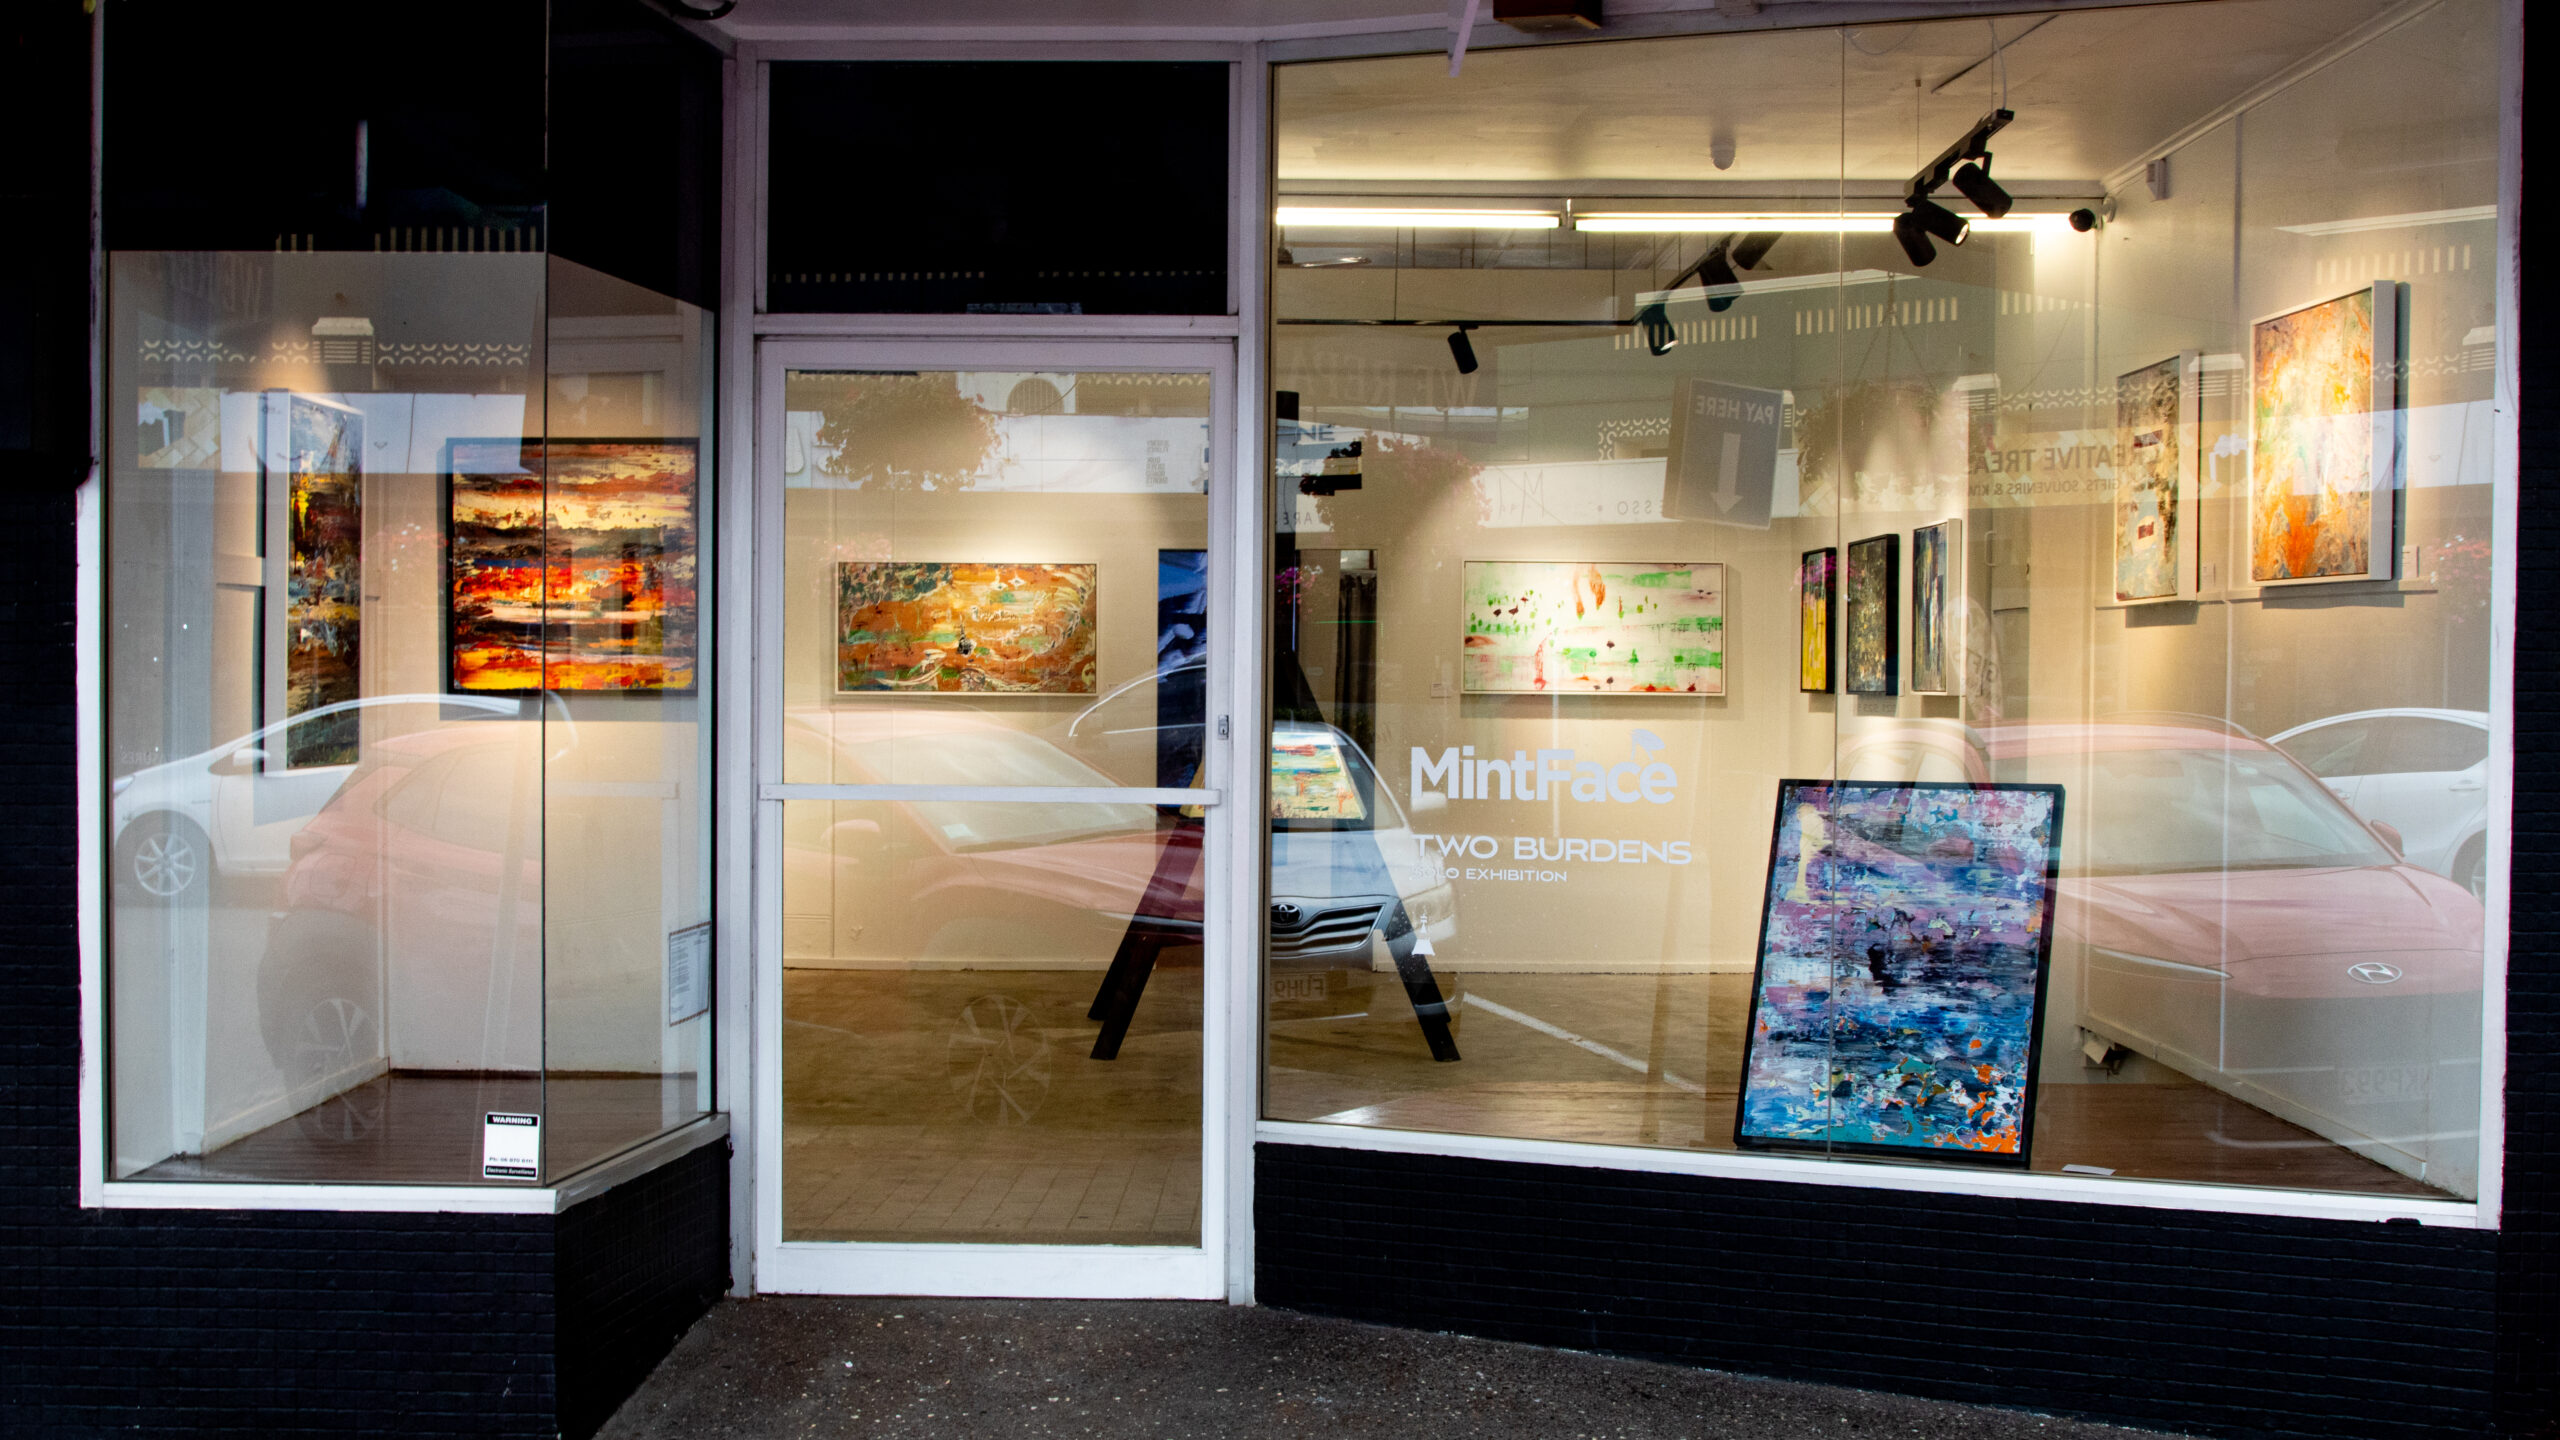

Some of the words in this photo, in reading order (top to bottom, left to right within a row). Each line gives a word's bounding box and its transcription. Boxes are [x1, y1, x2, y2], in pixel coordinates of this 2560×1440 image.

[1410, 745, 1678, 804] MintFace
[1411, 834, 1499, 860] TWO
[1513, 836, 1693, 866] BURDENS
[1465, 868, 1568, 882] EXHIBITION
[492, 1116, 533, 1125] WARNING
